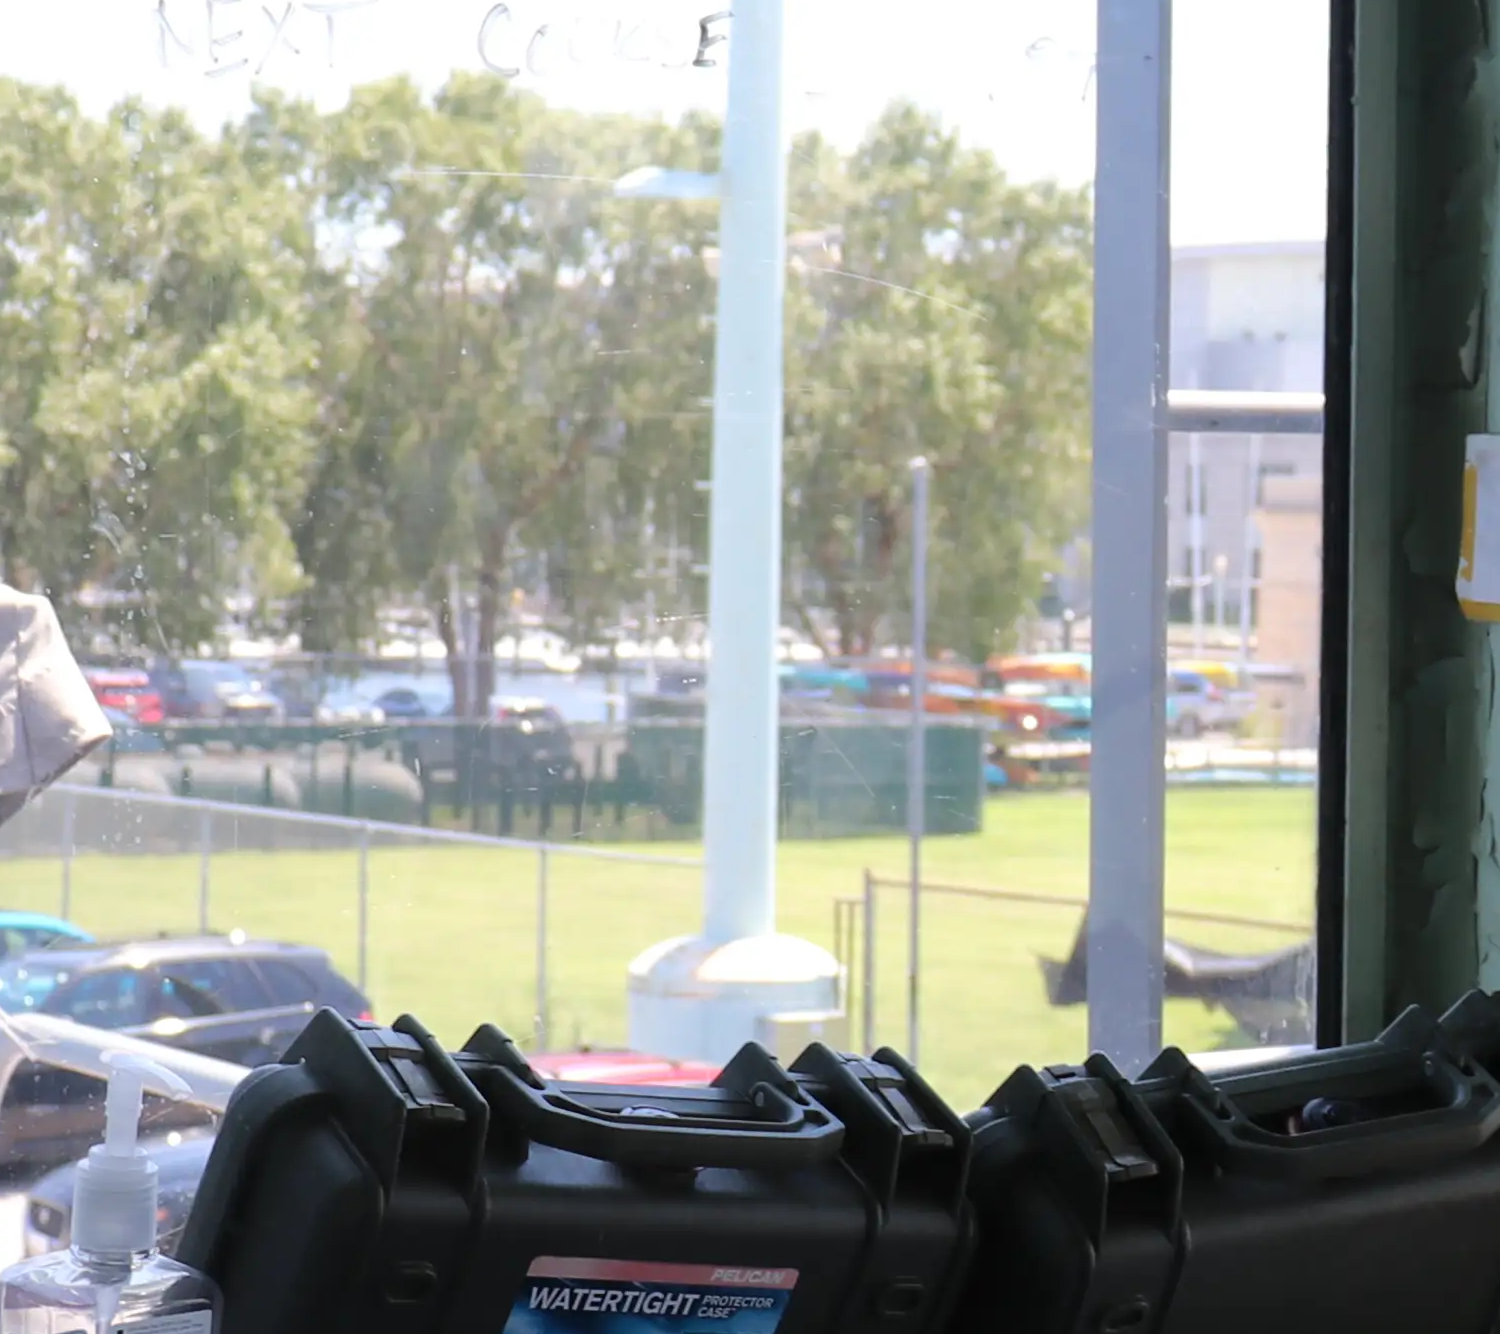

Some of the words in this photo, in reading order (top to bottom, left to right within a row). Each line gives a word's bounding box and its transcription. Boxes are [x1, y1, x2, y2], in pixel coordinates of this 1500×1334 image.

[710, 1267, 785, 1285] PELICAN
[527, 1285, 700, 1318] WATERTIGHT
[701, 1294, 775, 1310] PROTECTOR
